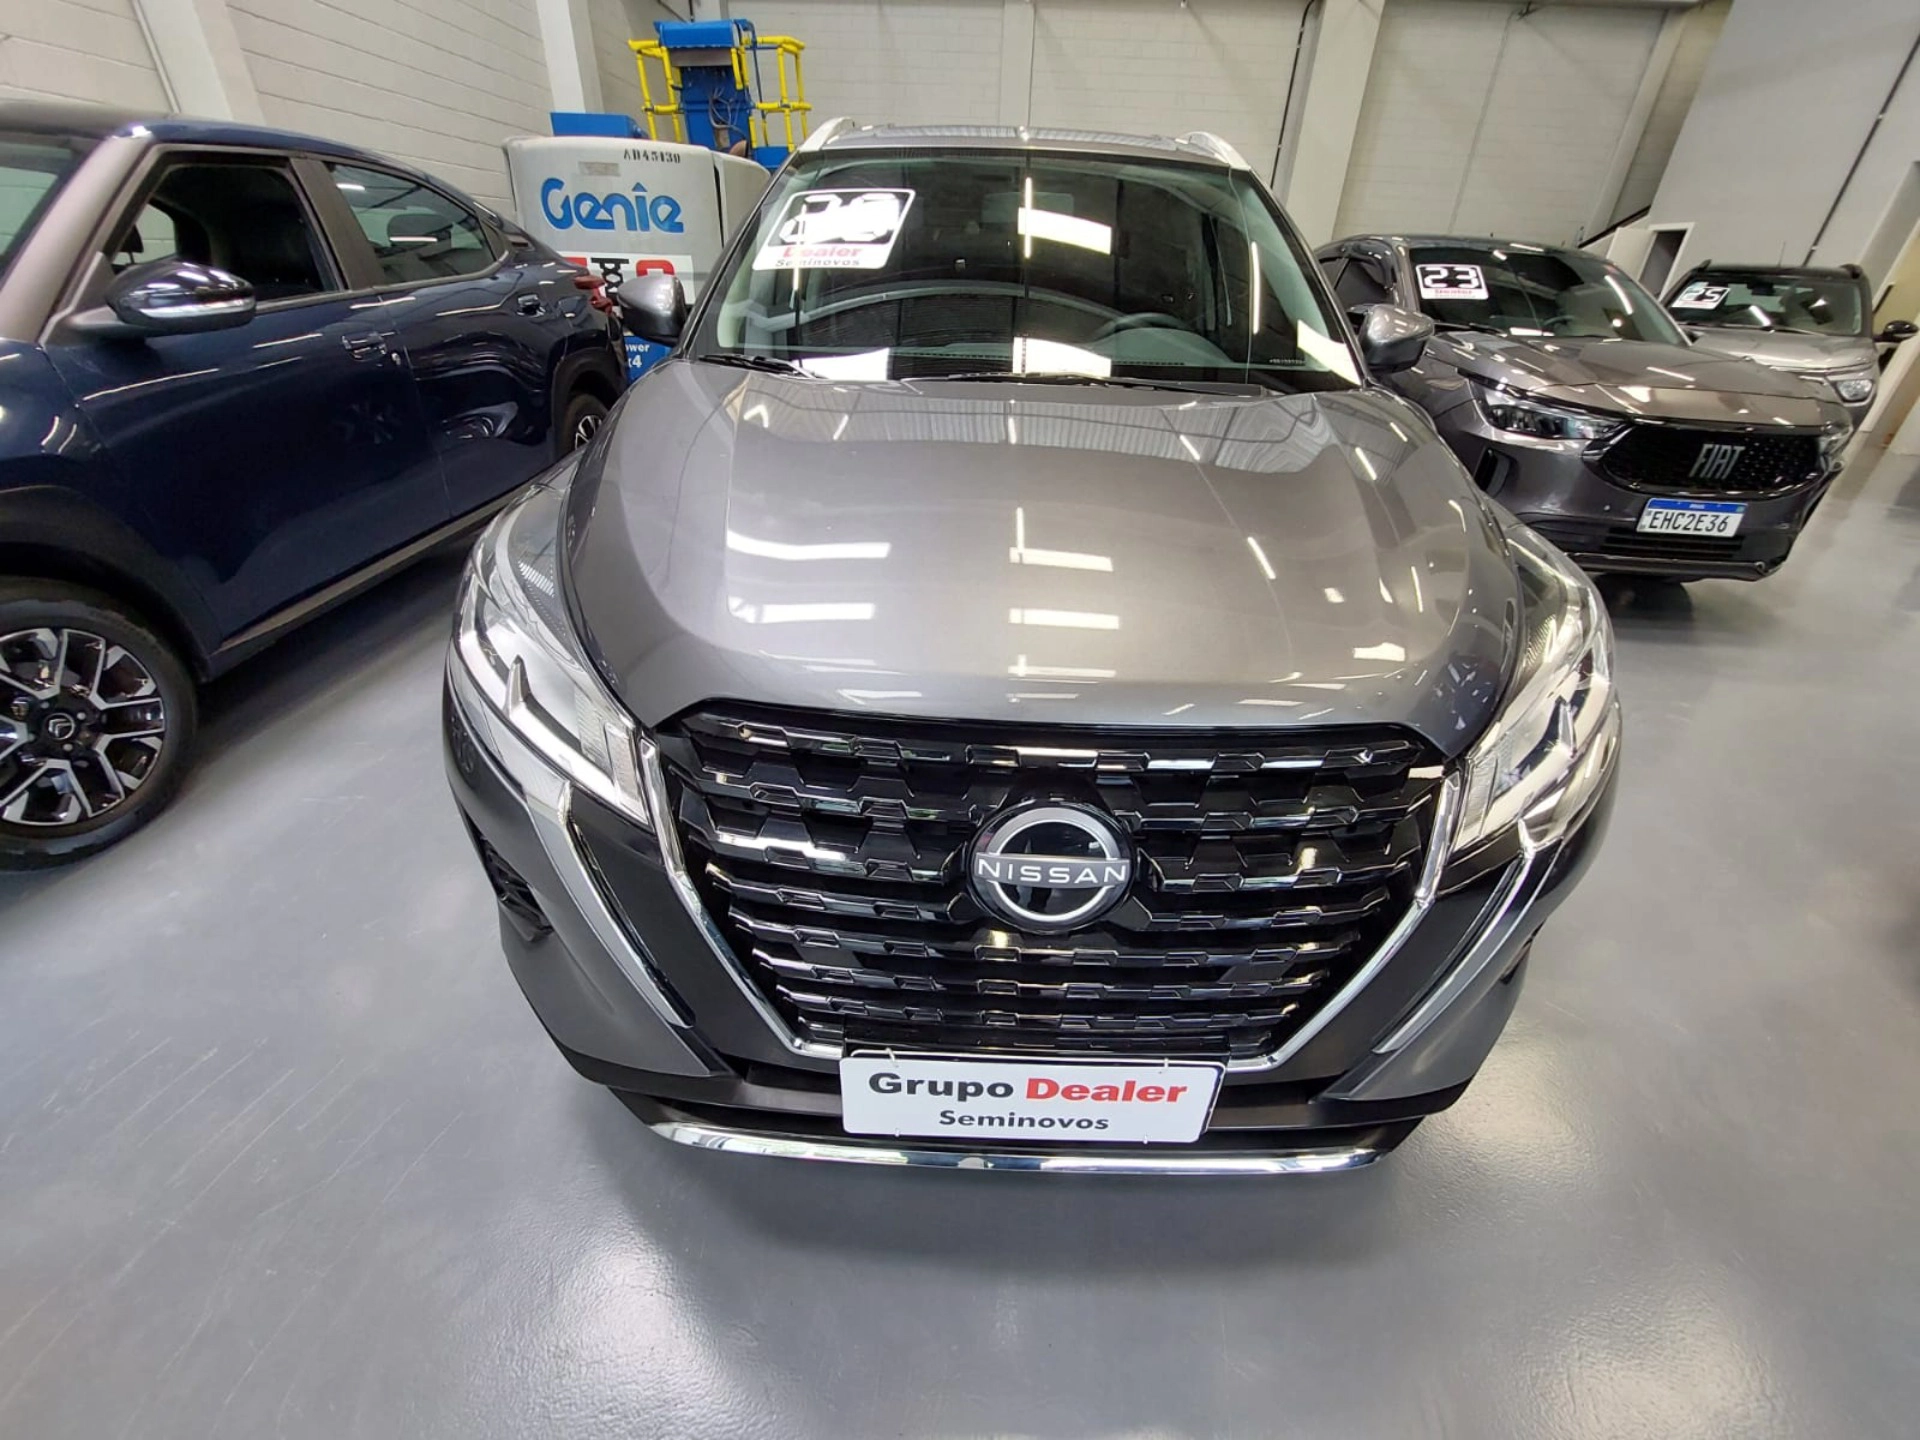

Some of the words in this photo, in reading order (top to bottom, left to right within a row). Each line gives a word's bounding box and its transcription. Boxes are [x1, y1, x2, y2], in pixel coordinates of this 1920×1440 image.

[1424, 267, 1480, 288] 23
[1689, 443, 1746, 480] FIAT
[1649, 511, 1730, 533] EHC2E36
[977, 858, 1127, 884] NISSAN
[868, 1072, 1015, 1102] Grupo
[1026, 1077, 1188, 1103] Dealer
[938, 1110, 1110, 1131] Seminovos
